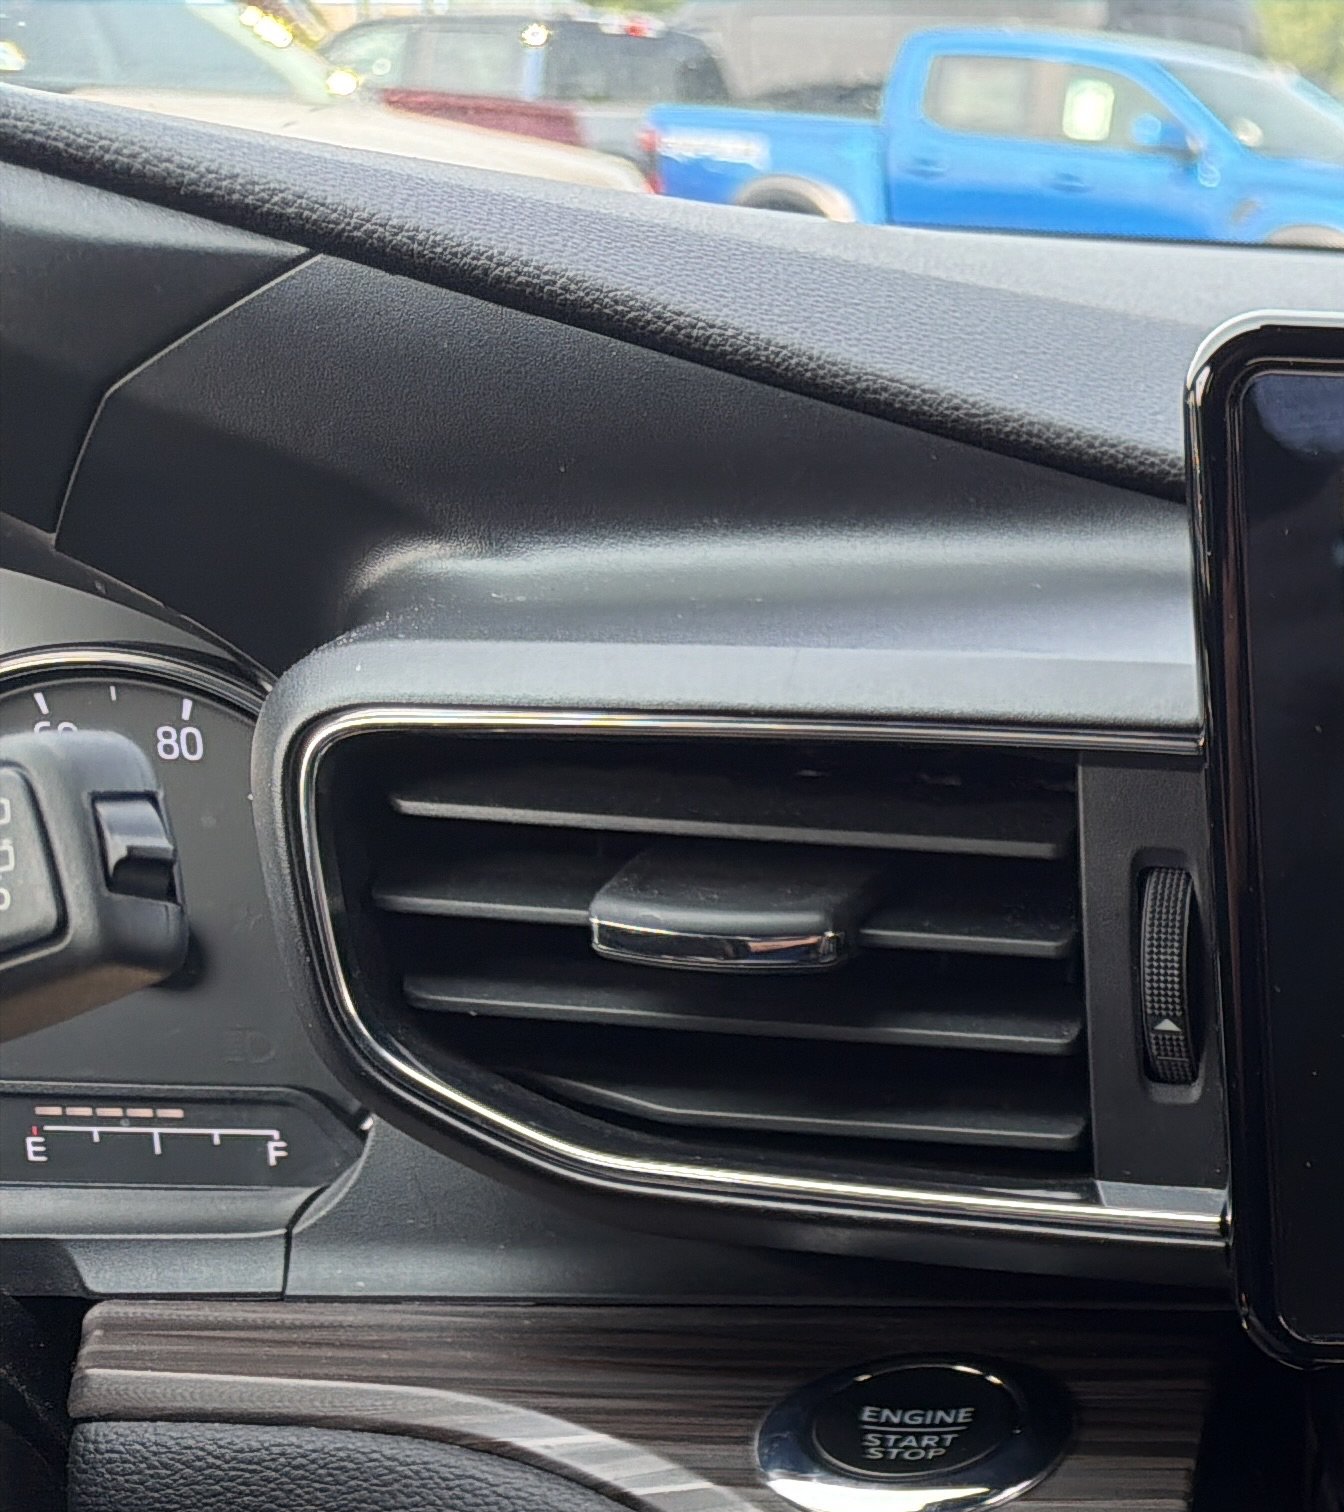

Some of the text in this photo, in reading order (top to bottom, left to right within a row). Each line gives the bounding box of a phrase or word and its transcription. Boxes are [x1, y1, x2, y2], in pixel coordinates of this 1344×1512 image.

[156, 725, 204, 761] 80
[25, 1136, 48, 1162] E
[266, 1140, 289, 1167] F
[859, 1406, 975, 1425] ENGINE
[862, 1433, 959, 1448] START
[863, 1448, 947, 1461] STOP
